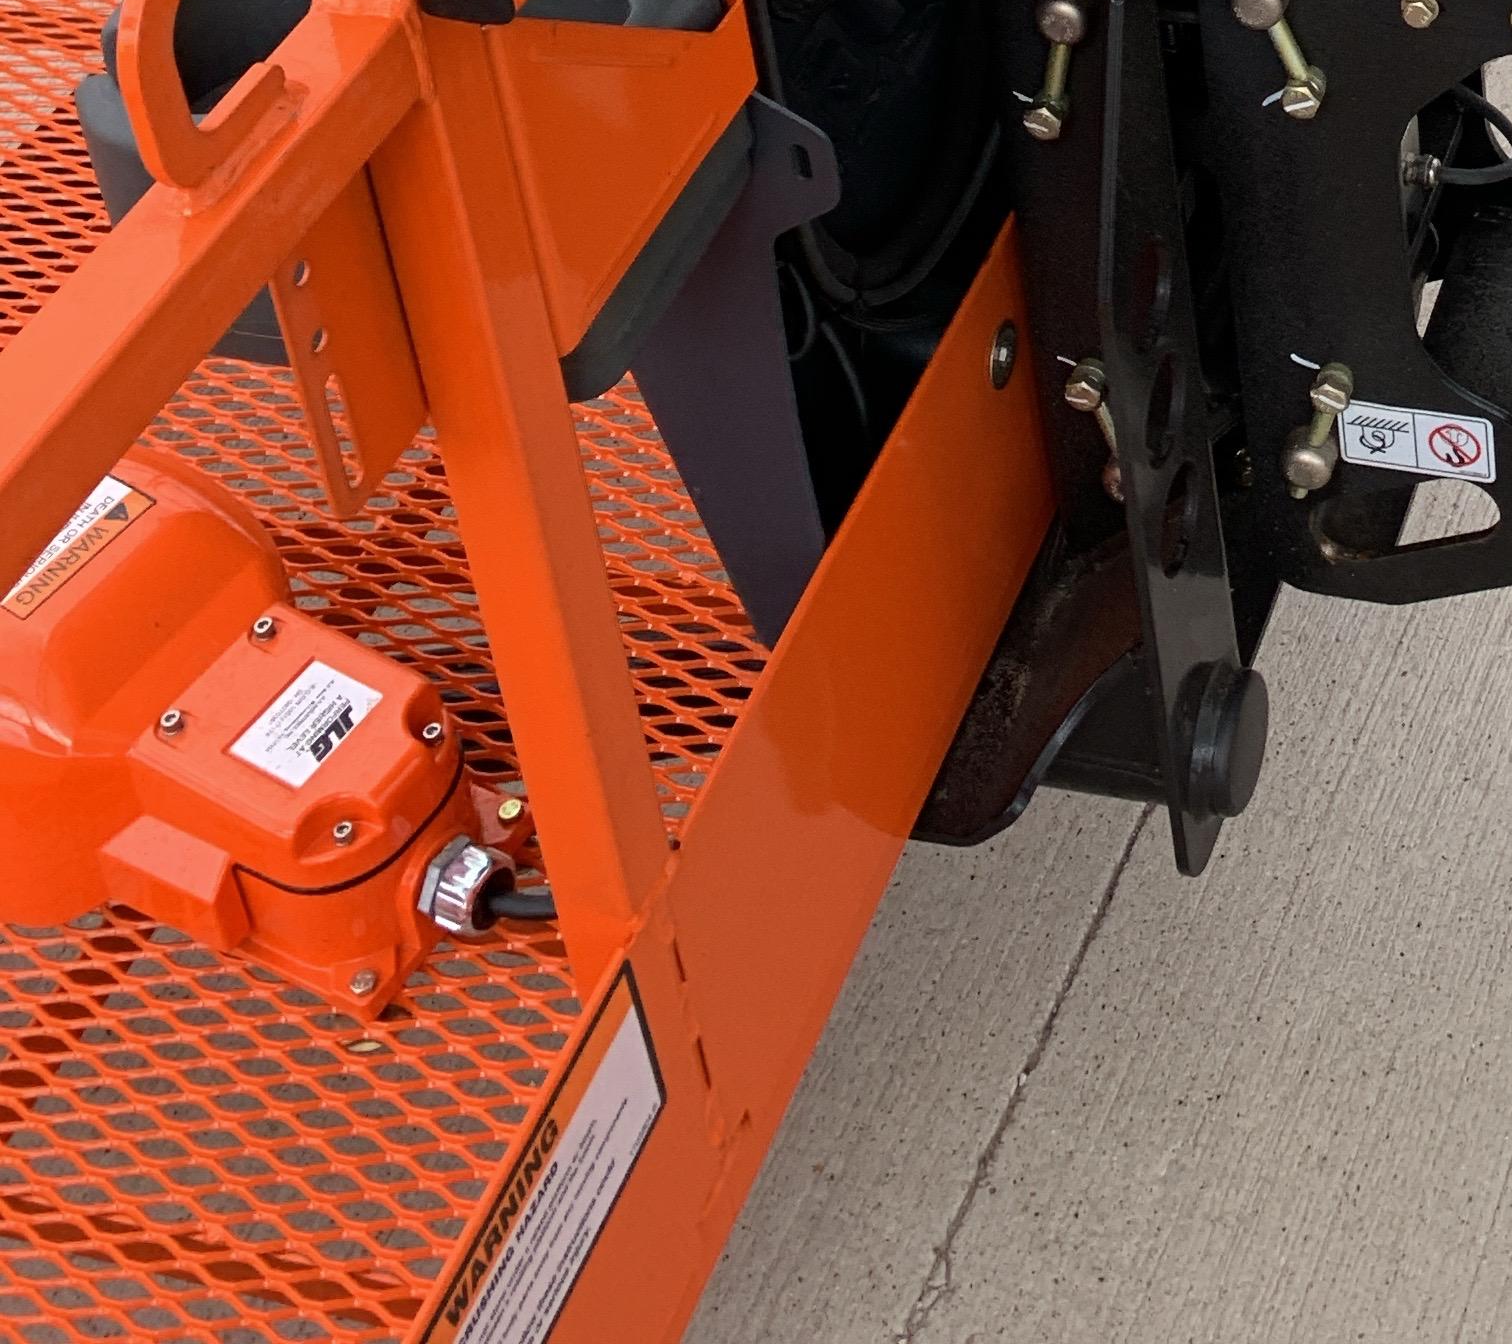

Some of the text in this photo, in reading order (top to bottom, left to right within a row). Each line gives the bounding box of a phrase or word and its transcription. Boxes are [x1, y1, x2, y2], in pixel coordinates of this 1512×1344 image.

[58, 528, 77, 543] OR
[77, 496, 114, 527] DEATH
[15, 527, 107, 605] WARNING
[286, 728, 310, 750] LEVEL
[295, 698, 350, 757] PERFORMING AT
[310, 701, 336, 728] HIGHER
[310, 705, 353, 761] JLG
[447, 1120, 557, 1324] WARNING
[516, 1162, 557, 1241] HAZARD
